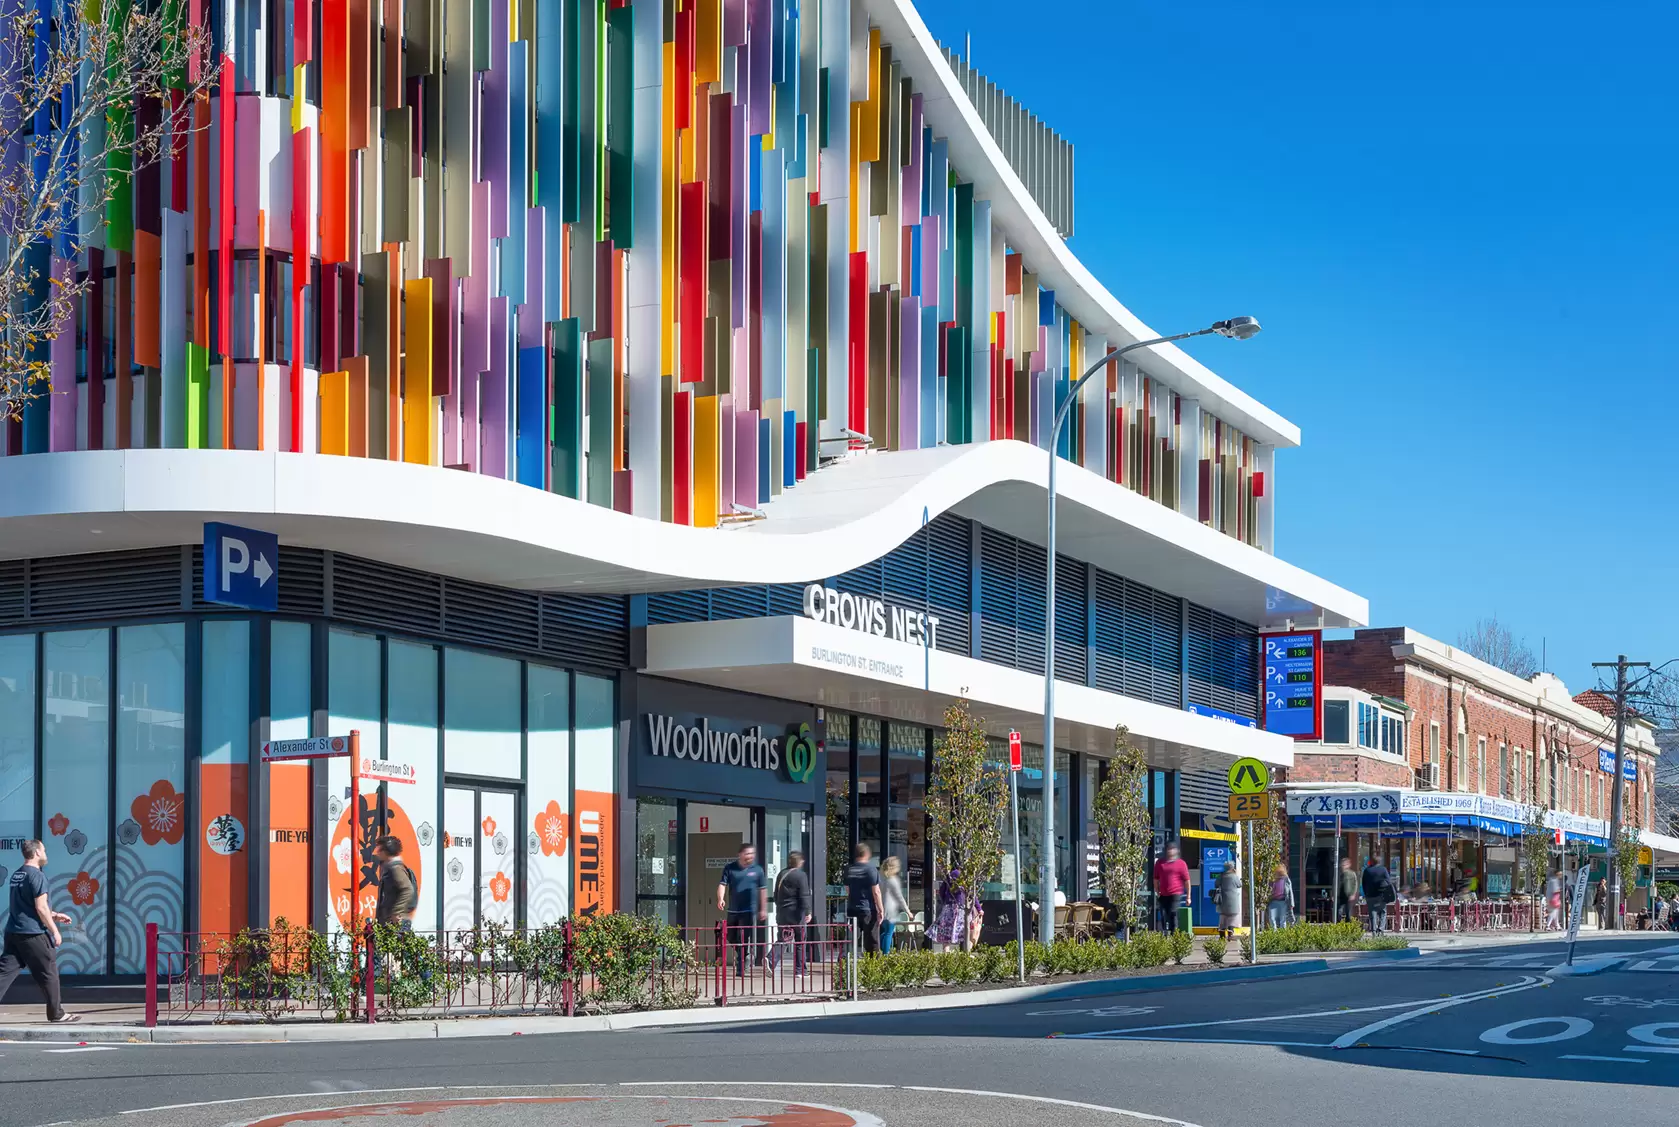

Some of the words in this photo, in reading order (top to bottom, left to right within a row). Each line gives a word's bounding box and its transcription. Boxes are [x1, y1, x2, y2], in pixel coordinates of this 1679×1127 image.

[221, 536, 250, 592] P
[805, 584, 887, 638] CROWS
[891, 605, 940, 650] NEST
[1266, 641, 1276, 654] P
[1293, 649, 1307, 657] 136
[811, 646, 857, 668] BURLINGTON
[857, 656, 869, 670] ST.
[868, 659, 904, 679] ENTRANCE
[1266, 666, 1276, 680] P
[1266, 691, 1276, 705] P
[273, 740, 317, 753] Alexander
[319, 738, 329, 750] St
[647, 713, 779, 771] Woolworths
[372, 759, 402, 776] Burlington
[402, 763, 410, 776] St
[1235, 795, 1262, 811] 25
[1455, 799, 1472, 808] 1969
[450, 836, 472, 848] UME-YA
[1217, 848, 1224, 858] P
[1576, 868, 1587, 901] KEEP
[1569, 906, 1579, 941] LEFT
